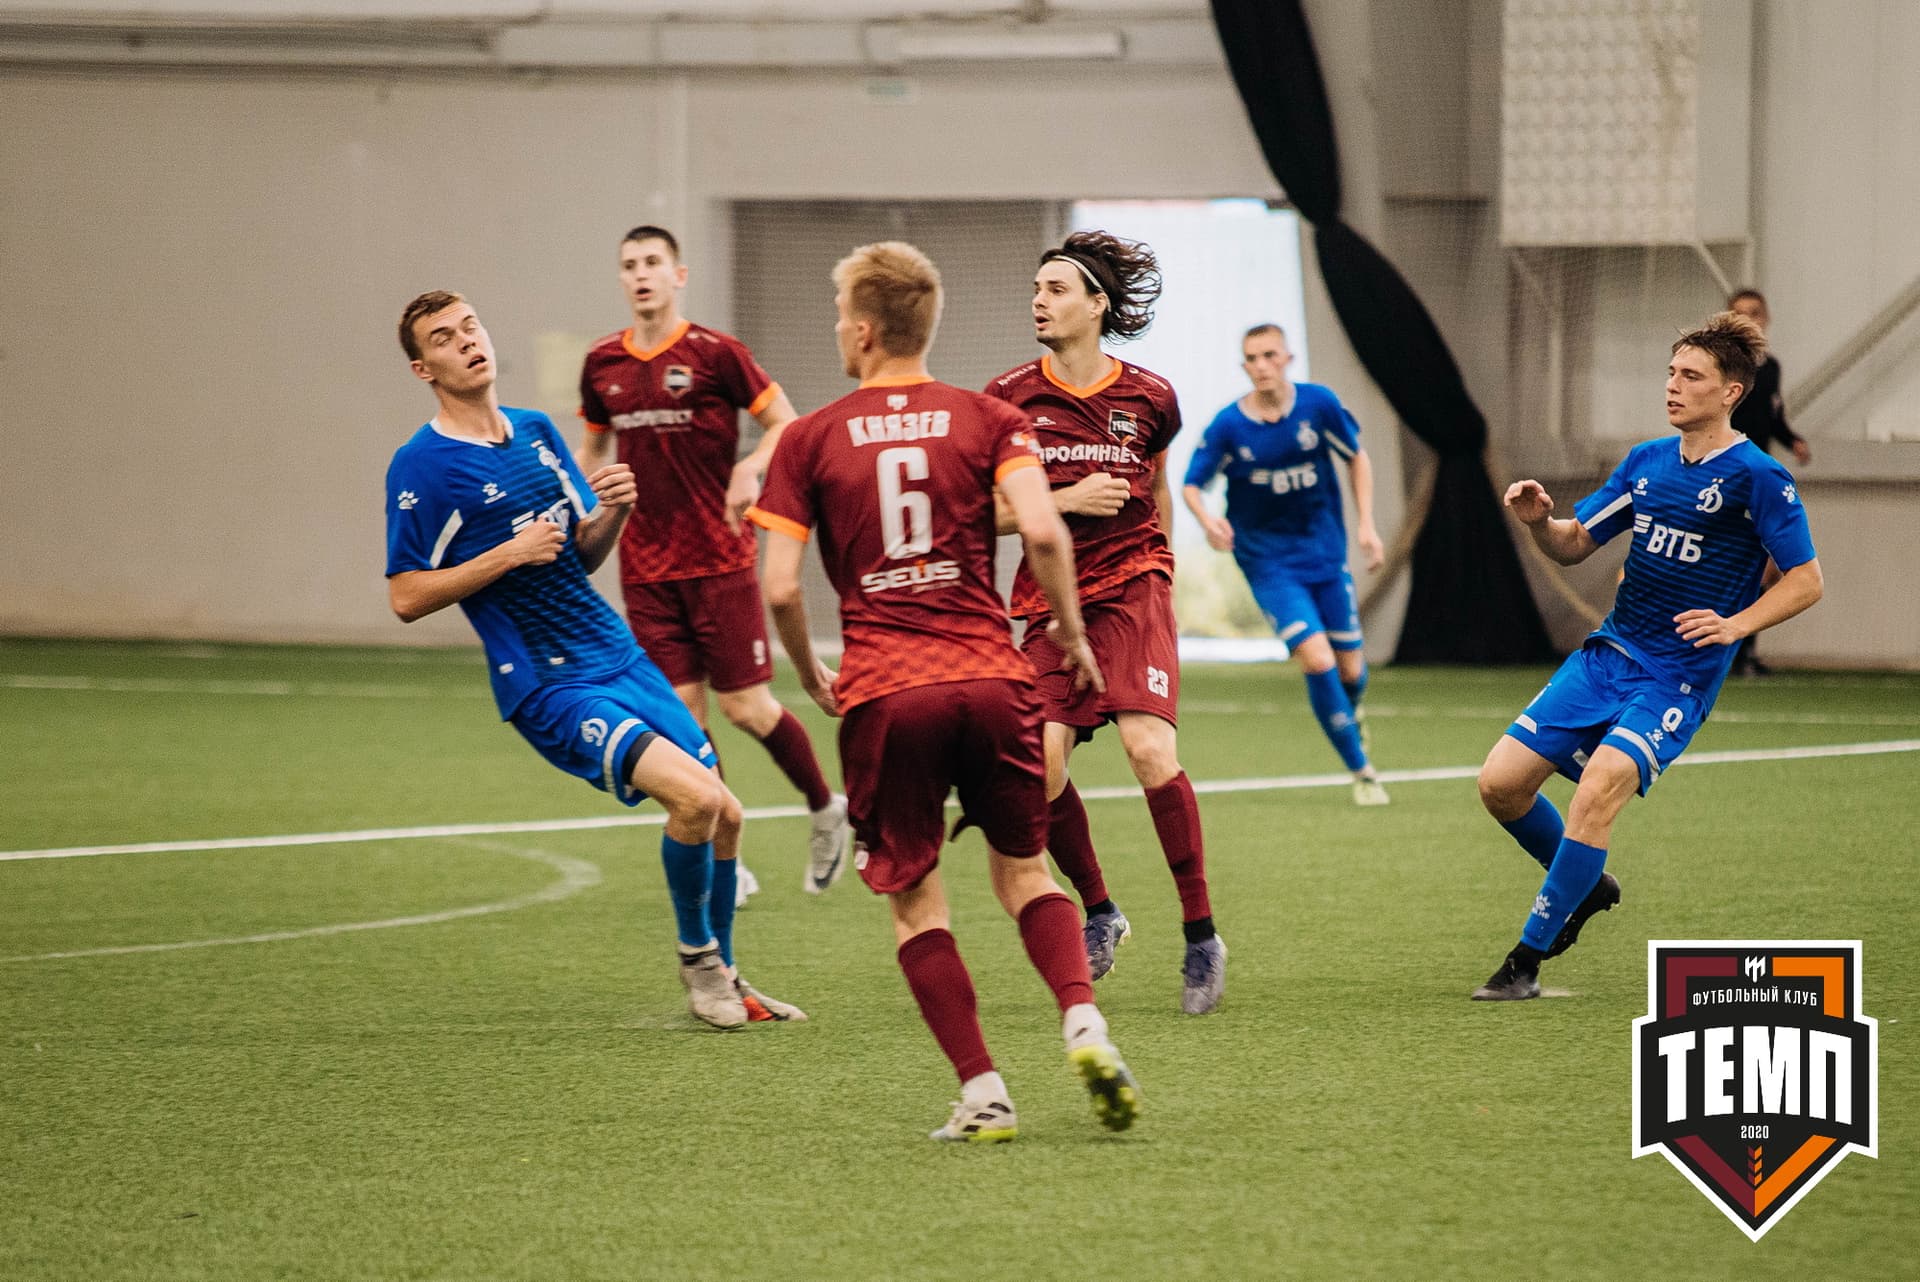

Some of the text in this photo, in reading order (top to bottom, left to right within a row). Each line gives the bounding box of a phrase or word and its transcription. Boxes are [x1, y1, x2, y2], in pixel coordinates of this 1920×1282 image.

[1272, 462, 1318, 494] ВТБ
[876, 446, 933, 560] 6
[1646, 524, 1704, 563] ВТБ
[1147, 666, 1169, 699] 23
